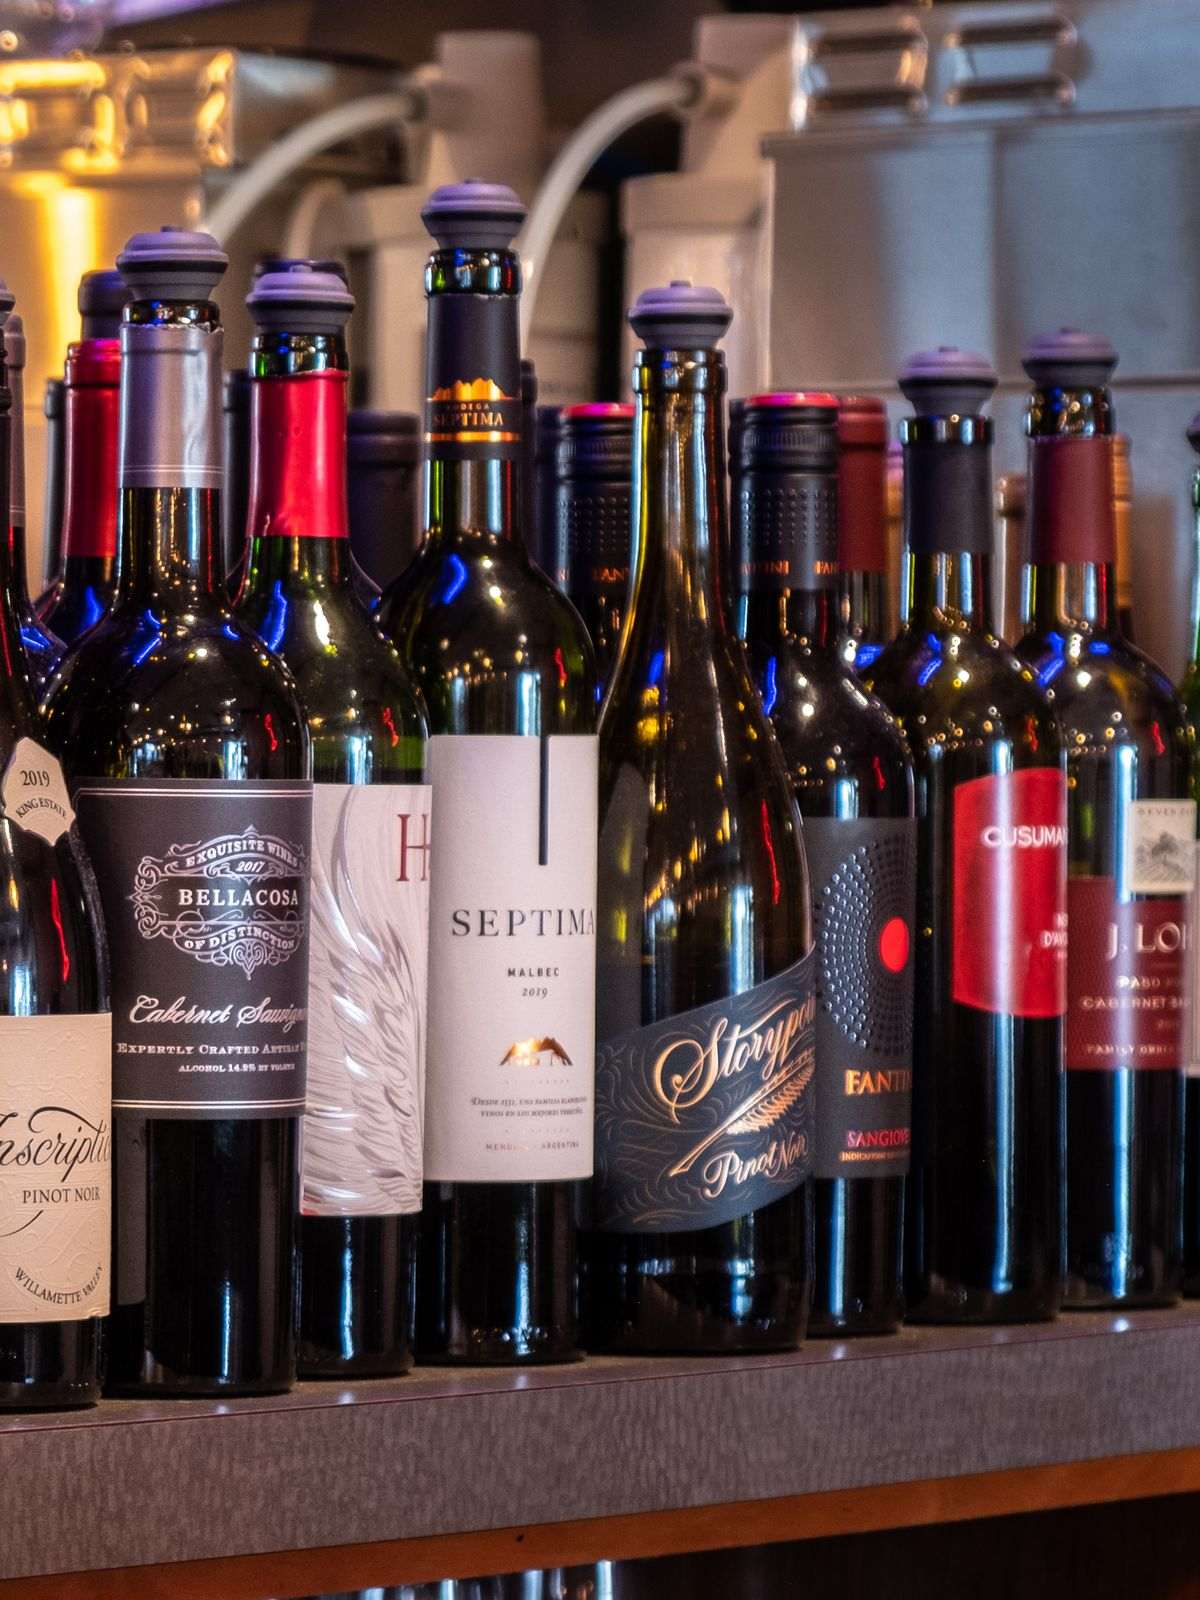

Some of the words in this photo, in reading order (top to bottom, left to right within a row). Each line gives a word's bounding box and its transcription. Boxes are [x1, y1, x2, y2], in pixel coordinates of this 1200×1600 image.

[20, 769, 50, 787] 2019
[16, 798, 39, 818] KING
[39, 797, 67, 819] ESTATE
[185, 840, 265, 867] EXQUISITE
[266, 841, 298, 867] WINES
[235, 861, 265, 873] 2017
[178, 888, 299, 907] BELLACOSA
[451, 907, 594, 937] SEPTIMA
[184, 940, 206, 950] OF
[208, 926, 295, 950] DISTINCTION
[507, 967, 560, 977] MALBEC
[521, 987, 548, 999] 2019
[129, 995, 234, 1024] Cabernet
[178, 1064, 227, 1073] ALCOHOL
[703, 1141, 780, 1198] Pinot
[23, 1188, 71, 1204] PINOT
[74, 1186, 101, 1201] NOIR
[16, 1267, 82, 1305] WILLAMETTE
